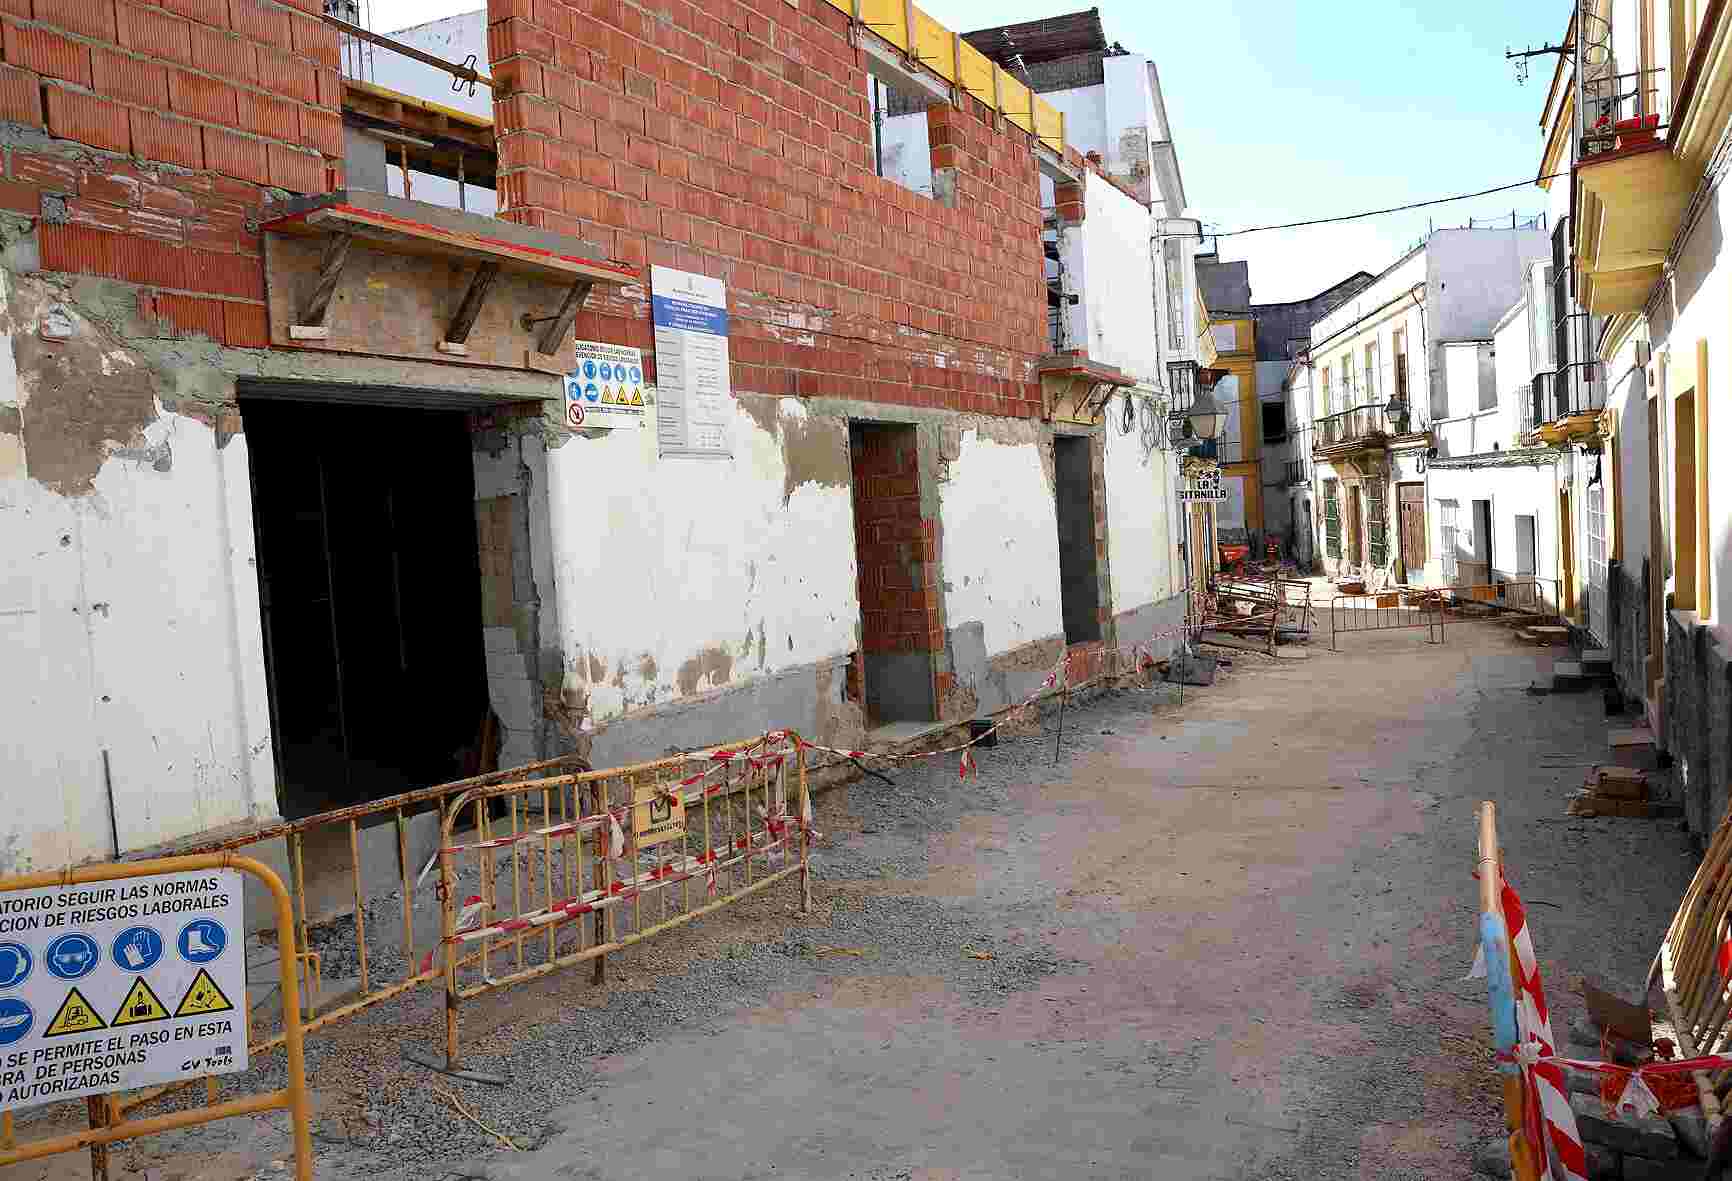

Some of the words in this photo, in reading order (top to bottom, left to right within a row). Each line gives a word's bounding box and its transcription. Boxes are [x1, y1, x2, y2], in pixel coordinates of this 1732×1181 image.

[57, 888, 115, 907] SEGUIR
[120, 885, 149, 900] LAS
[153, 878, 218, 897] NORMAS
[44, 913, 65, 927] DE
[70, 905, 138, 924] RIESGOS
[143, 894, 229, 915] LABORALES
[7, 1051, 29, 1068] SE
[33, 1039, 103, 1063] PERMITE
[107, 1037, 125, 1051] EL
[130, 1030, 170, 1046] PASO
[174, 1025, 194, 1041] EN
[198, 1020, 232, 1036] ESTA
[0, 1070, 26, 1087] RA
[36, 1065, 57, 1080] DE
[63, 1050, 146, 1074] PERSONAS
[8, 1070, 120, 1102] AUTORIZADAS
